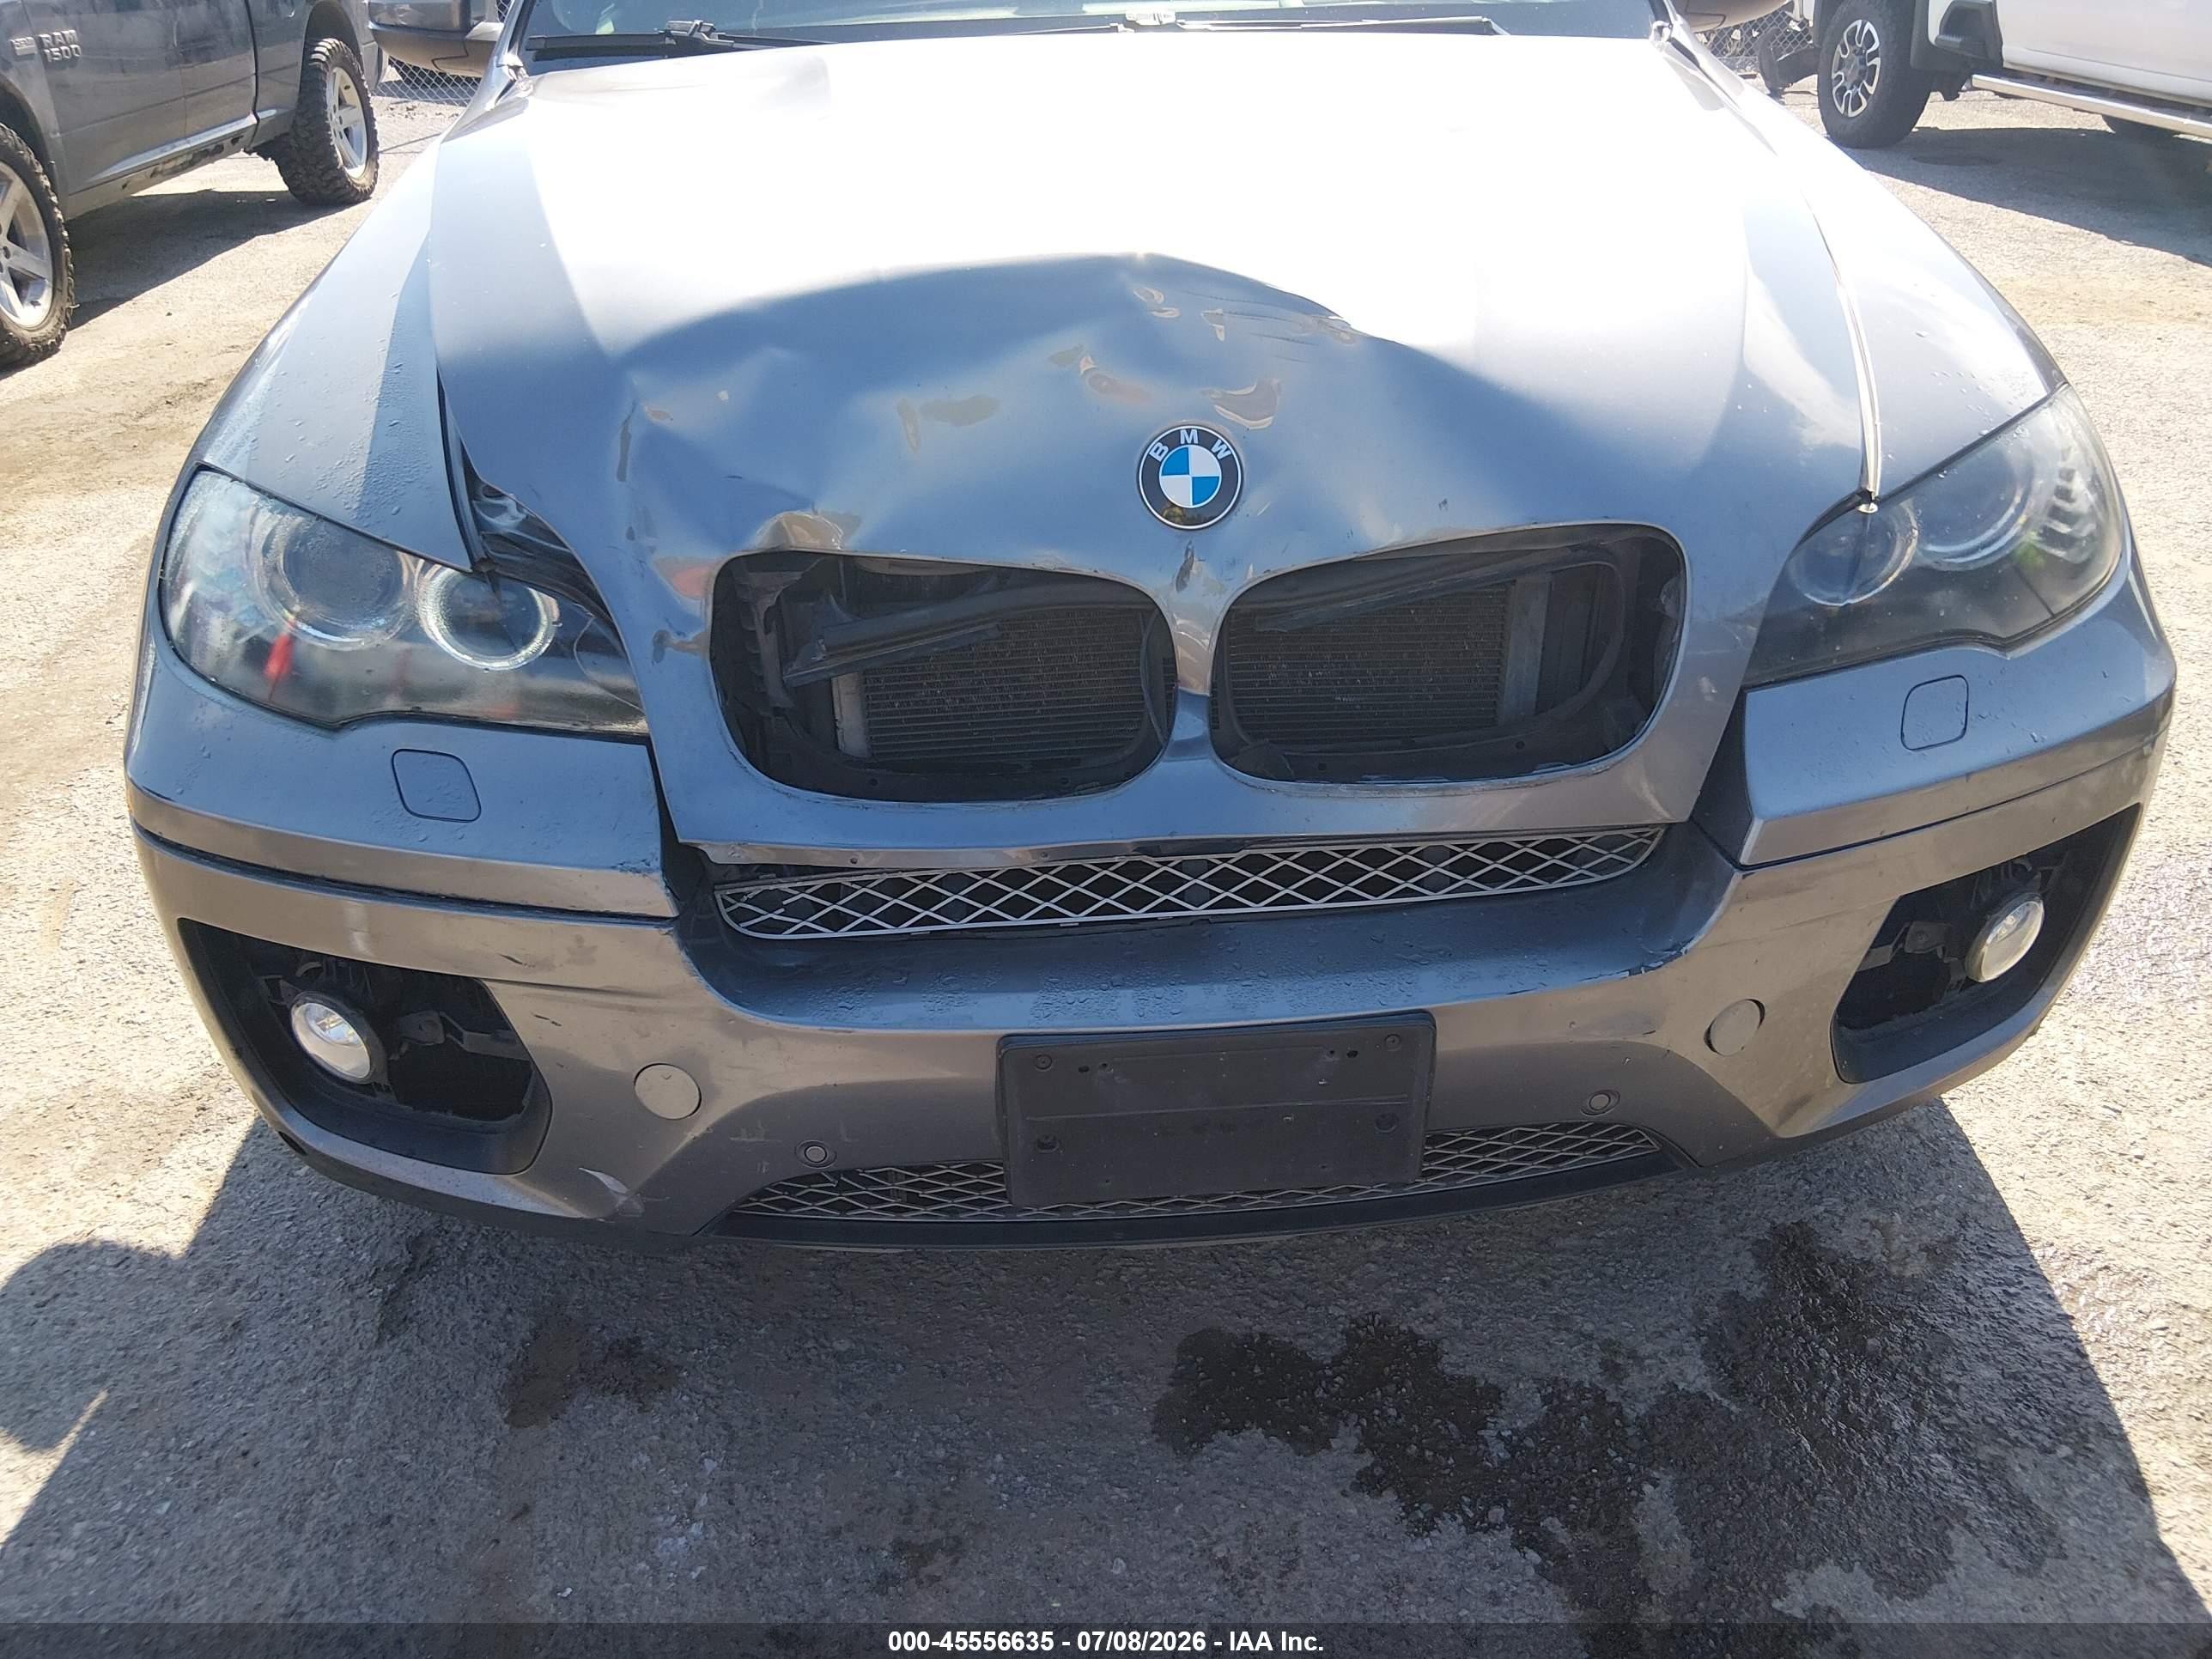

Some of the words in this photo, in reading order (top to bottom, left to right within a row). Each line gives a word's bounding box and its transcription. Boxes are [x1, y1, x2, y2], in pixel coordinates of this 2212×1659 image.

[39, 29, 78, 48] RAM
[44, 44, 82, 62] 1500
[1149, 429, 1231, 462] BMW
